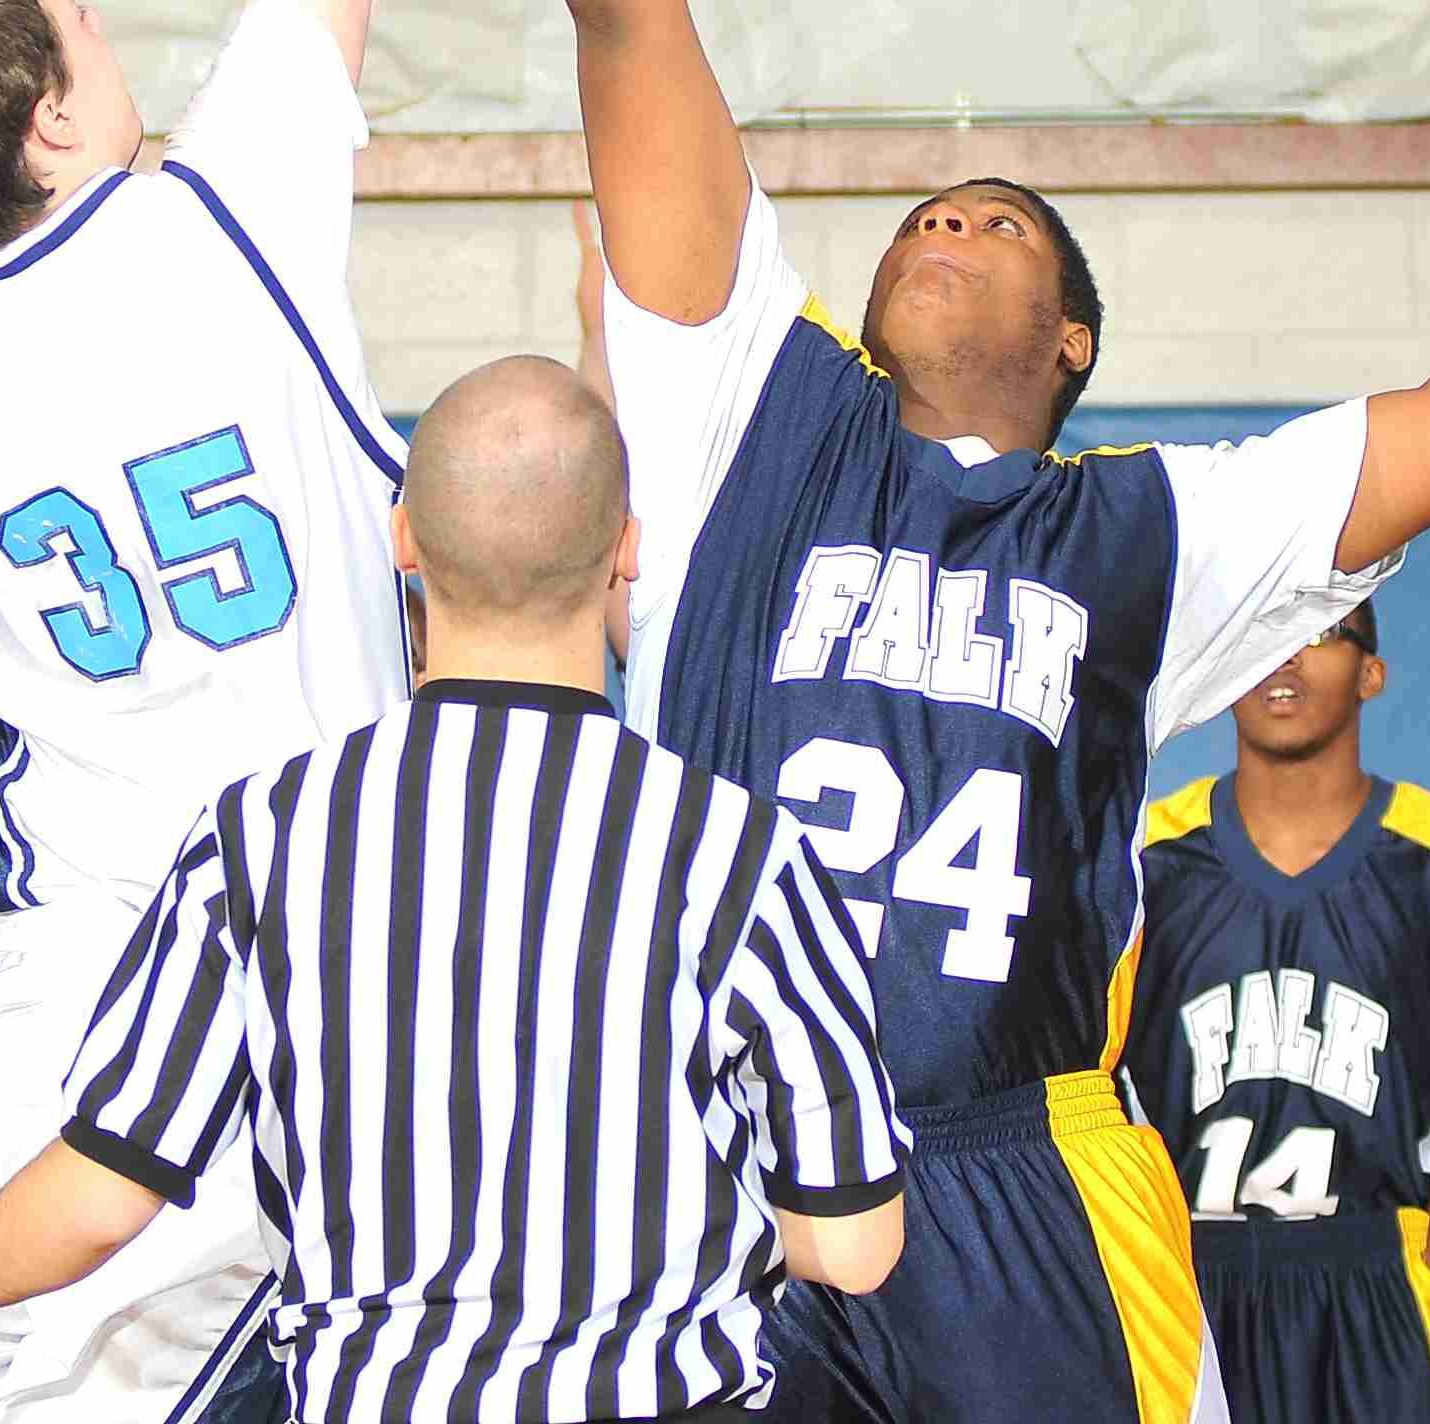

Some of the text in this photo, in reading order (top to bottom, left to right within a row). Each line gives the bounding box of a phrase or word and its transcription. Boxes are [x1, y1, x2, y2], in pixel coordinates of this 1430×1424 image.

[771, 544, 1089, 748] FALK
[776, 736, 1032, 984] 24
[1179, 967, 1389, 1118] FALK
[1190, 1116, 1340, 1221] 14
